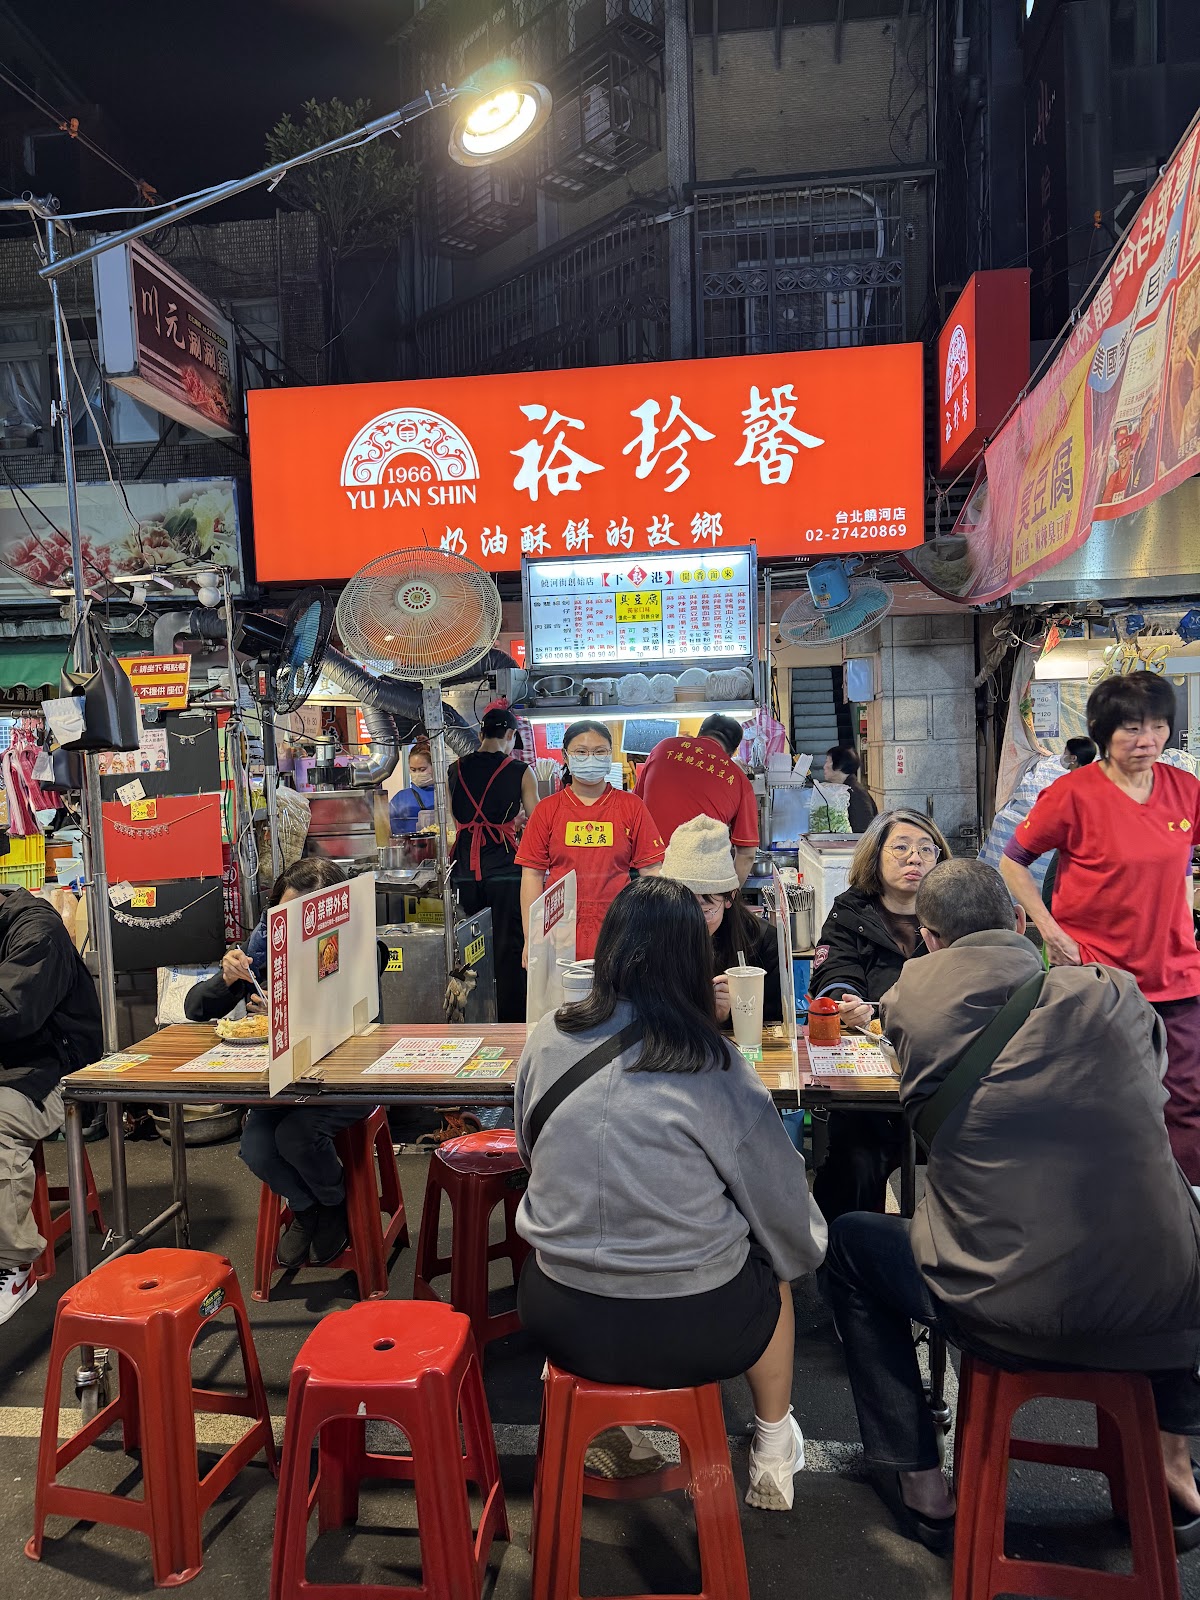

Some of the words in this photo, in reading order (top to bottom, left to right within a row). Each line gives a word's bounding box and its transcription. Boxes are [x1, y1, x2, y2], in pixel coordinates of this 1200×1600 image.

[510, 384, 825, 502] 裕珍馨
[388, 466, 432, 484] 1966
[346, 490, 375, 510] YU
[383, 488, 420, 509] JAN
[427, 485, 477, 506] SHIN
[836, 507, 906, 524] 台北饒河店
[440, 511, 724, 557] 奶油酥餅的故鄉
[805, 524, 907, 542] 02-27420869
[620, 593, 658, 606] 臭豆腐
[317, 891, 349, 921] 禁帶外食
[273, 956, 284, 1054] 禁帶外食
